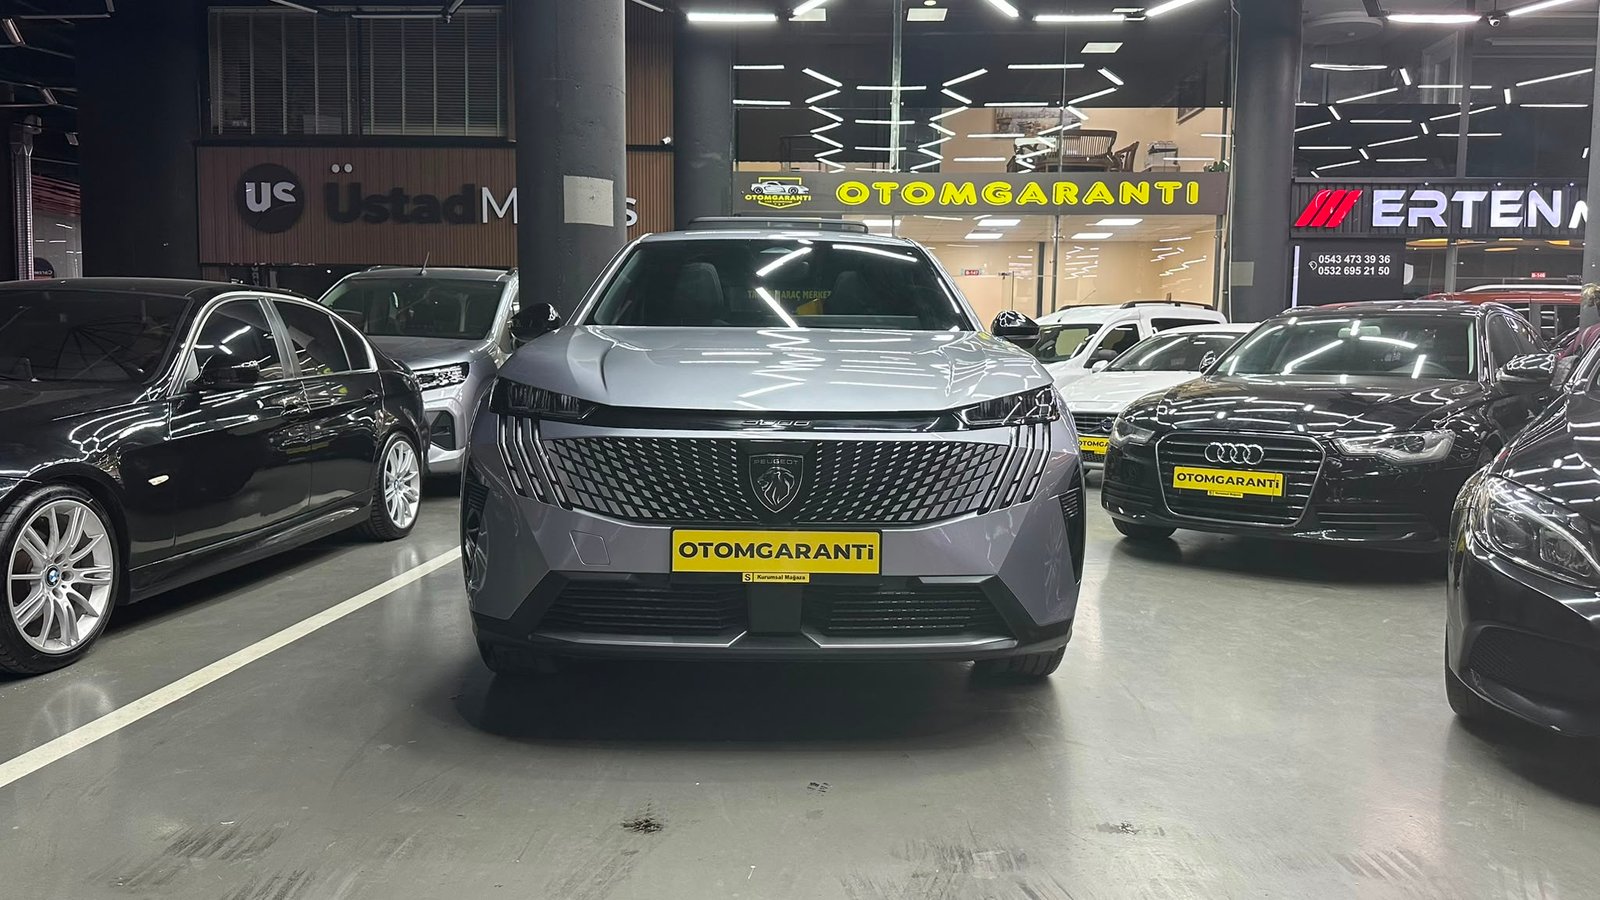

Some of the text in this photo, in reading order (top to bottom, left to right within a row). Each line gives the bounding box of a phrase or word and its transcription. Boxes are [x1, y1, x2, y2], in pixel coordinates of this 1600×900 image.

[835, 181, 1199, 206] OTOMGARANTI
[1371, 189, 1562, 228] ERTEN
[1318, 254, 1391, 264] 0543 473 39 36
[1317, 266, 1390, 275] 0532 695 21 50
